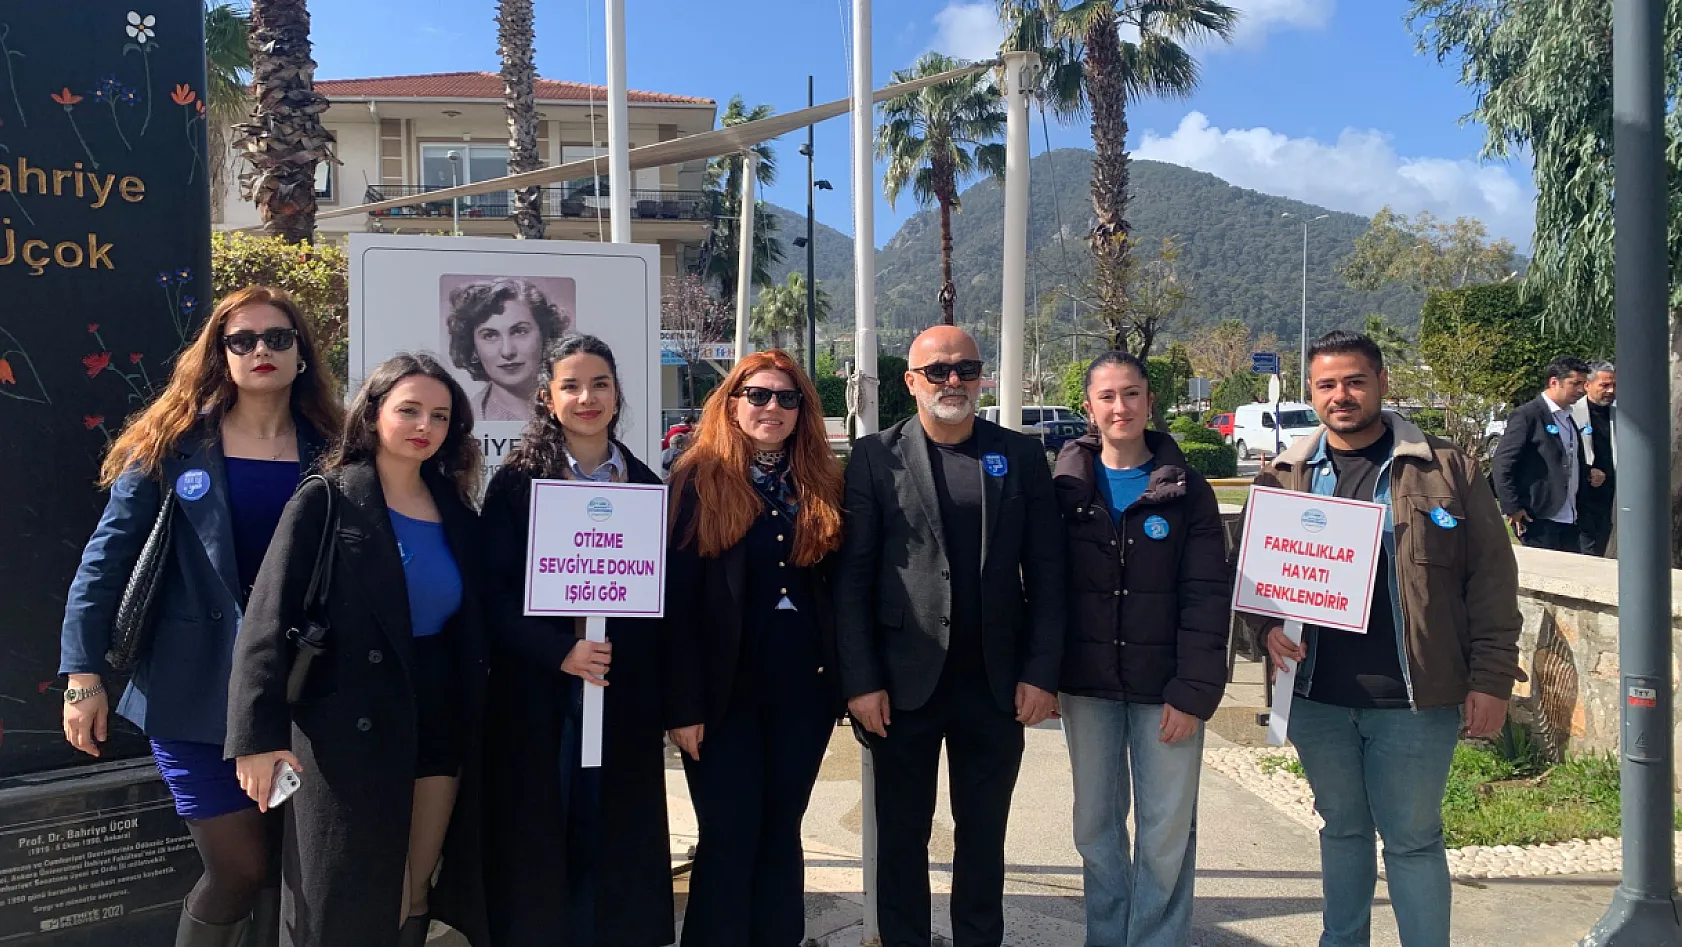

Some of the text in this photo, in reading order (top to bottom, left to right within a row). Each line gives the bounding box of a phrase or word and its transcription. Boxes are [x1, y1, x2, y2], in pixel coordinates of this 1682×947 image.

[574, 527, 624, 549] OTİZME
[1264, 535, 1355, 563] FARKLILIKLAR
[538, 553, 655, 576] SEVGİYLE DOKUN
[1281, 562, 1330, 584] HAYATI
[565, 580, 627, 604] IŞIĞI GÖR
[1255, 582, 1349, 612] RENKLENDİRİR
[18, 815, 138, 849] Prof. Dr. Bahriye ÜÇOK
[102, 904, 124, 920] 2021
